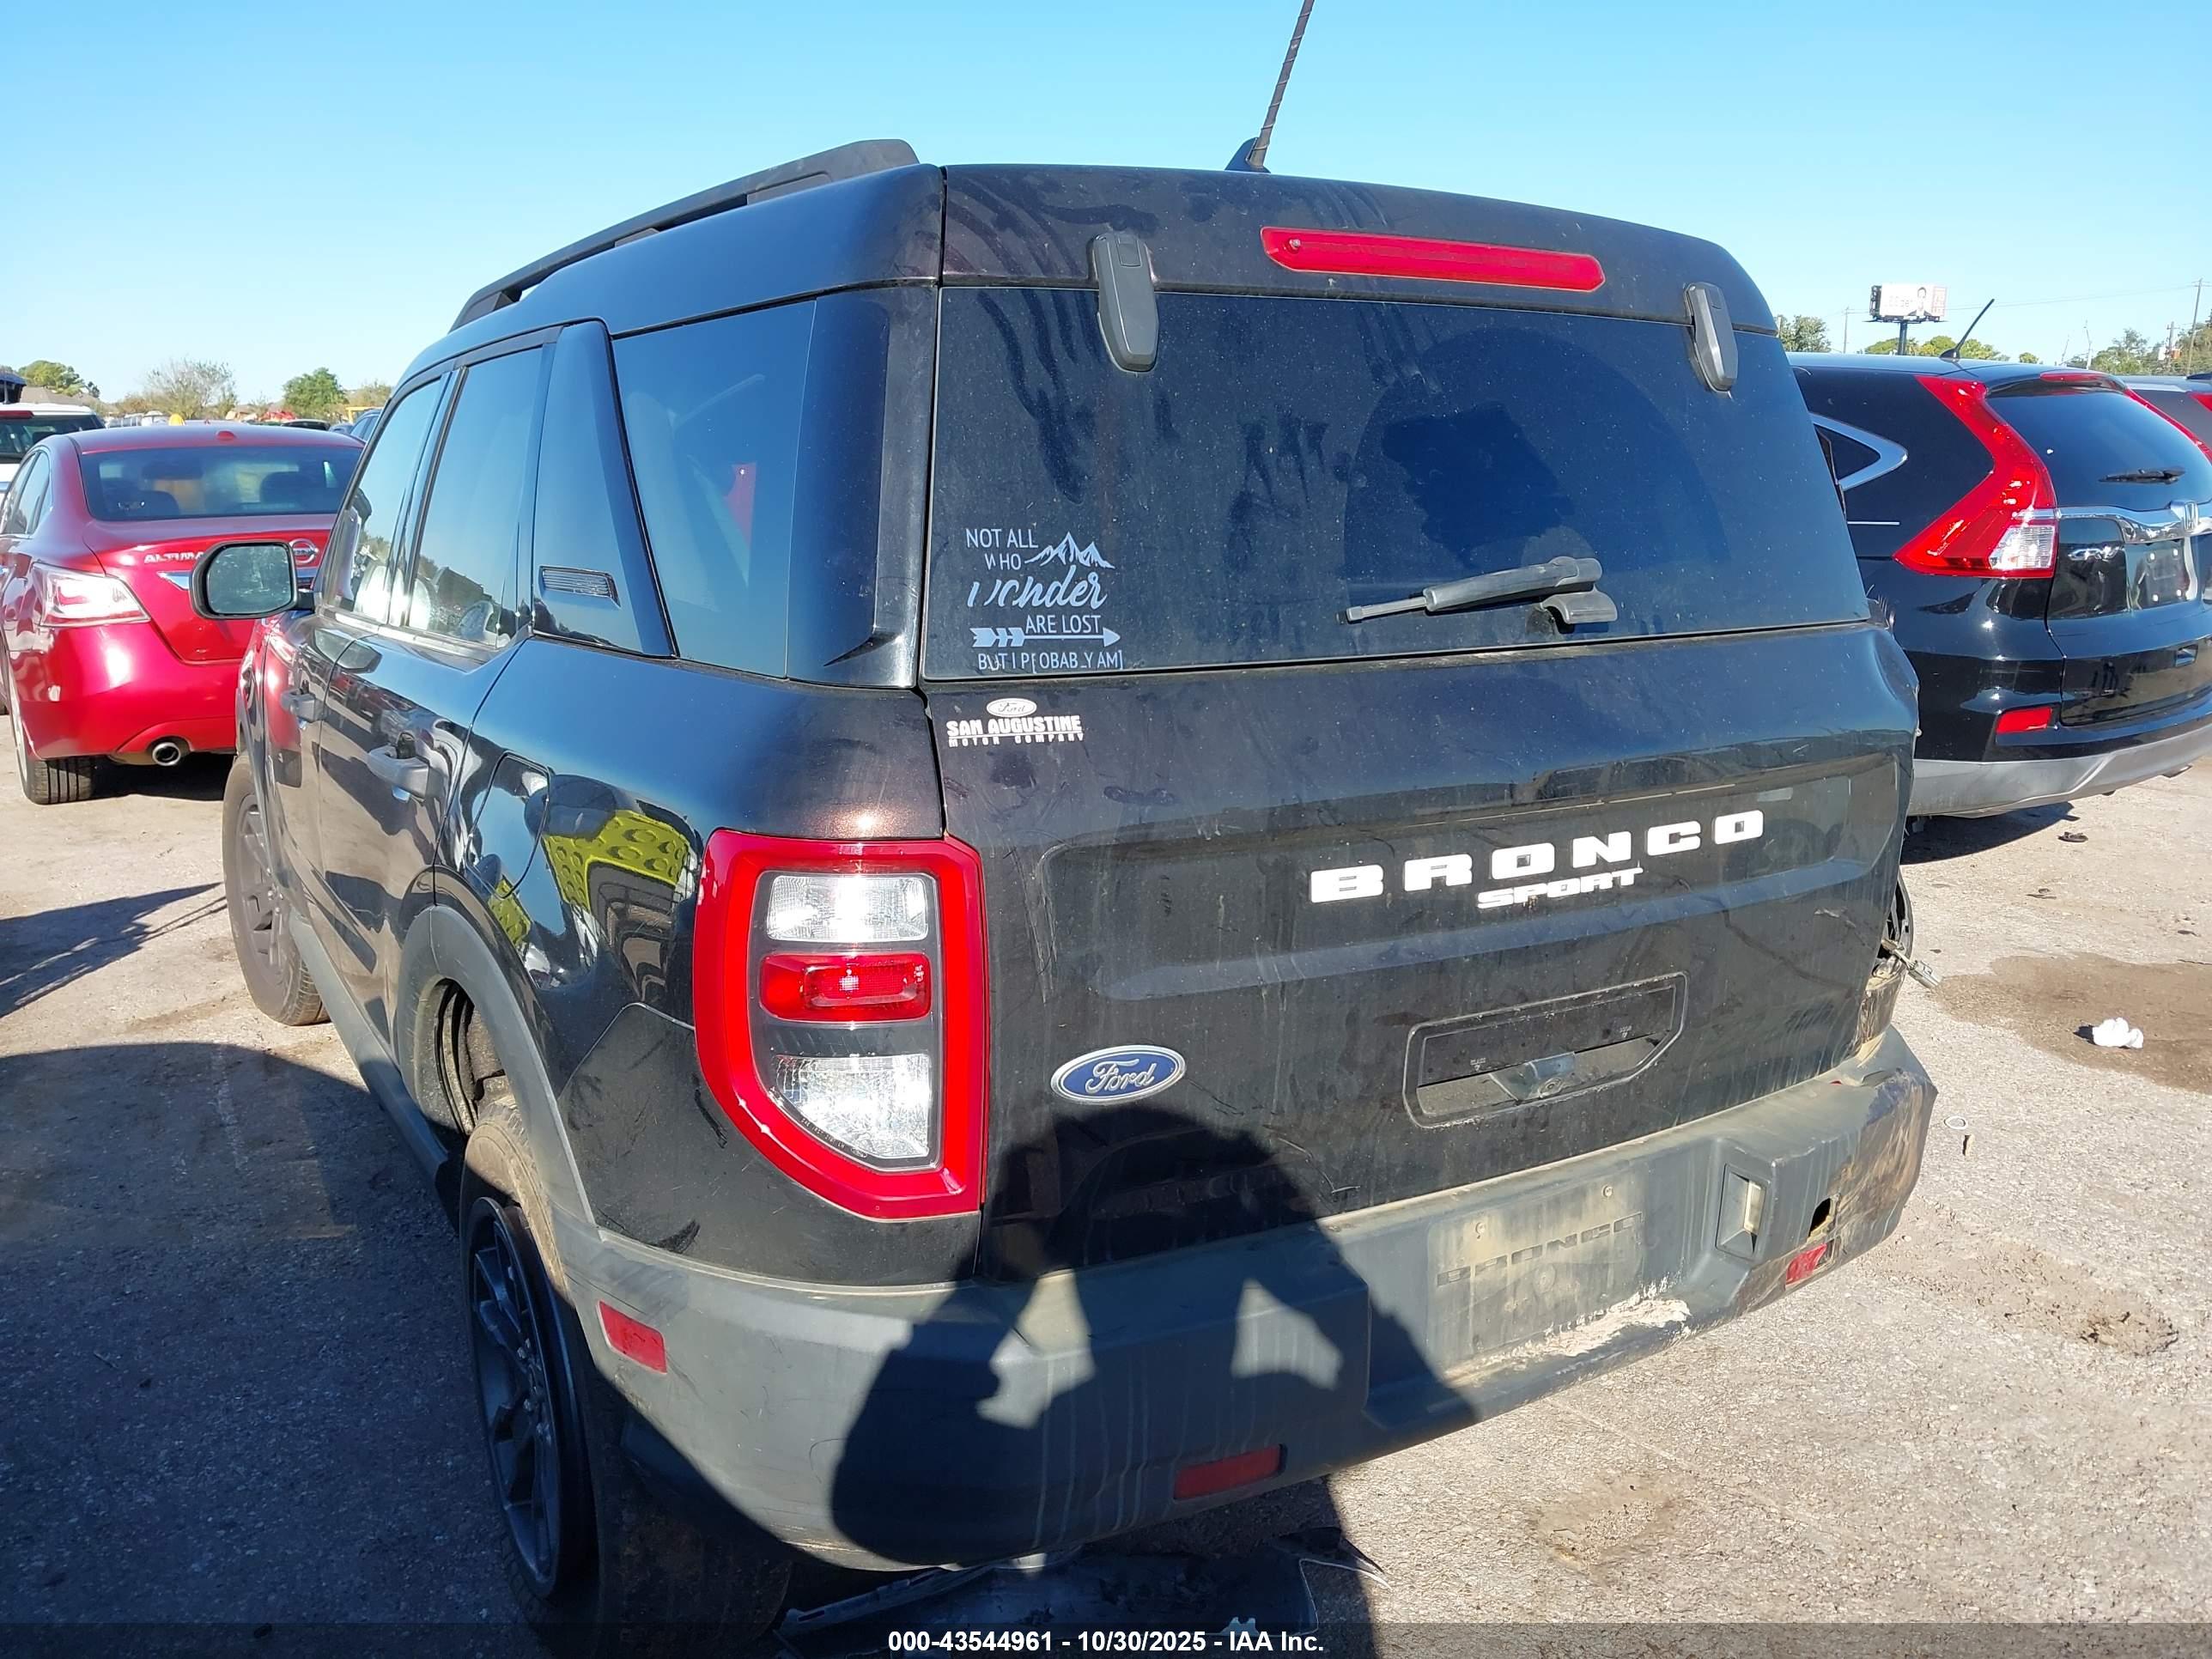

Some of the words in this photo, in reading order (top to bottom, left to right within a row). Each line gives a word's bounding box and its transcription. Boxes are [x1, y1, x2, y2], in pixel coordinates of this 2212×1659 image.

[965, 528, 1001, 548] NOT
[1006, 528, 1039, 549] ALL
[1025, 615, 1056, 634] ARE
[1061, 615, 1101, 634] LOST
[978, 653, 1007, 671] BUT
[945, 720, 984, 737] SAN
[988, 715, 1083, 734] AUGUSTINE
[948, 736, 1000, 748] MOTOR
[1014, 732, 1085, 744] COMPANY
[1310, 809, 1765, 903] BRONCO
[1477, 866, 1644, 909] SPORT
[1085, 1058, 1158, 1095] Ford
